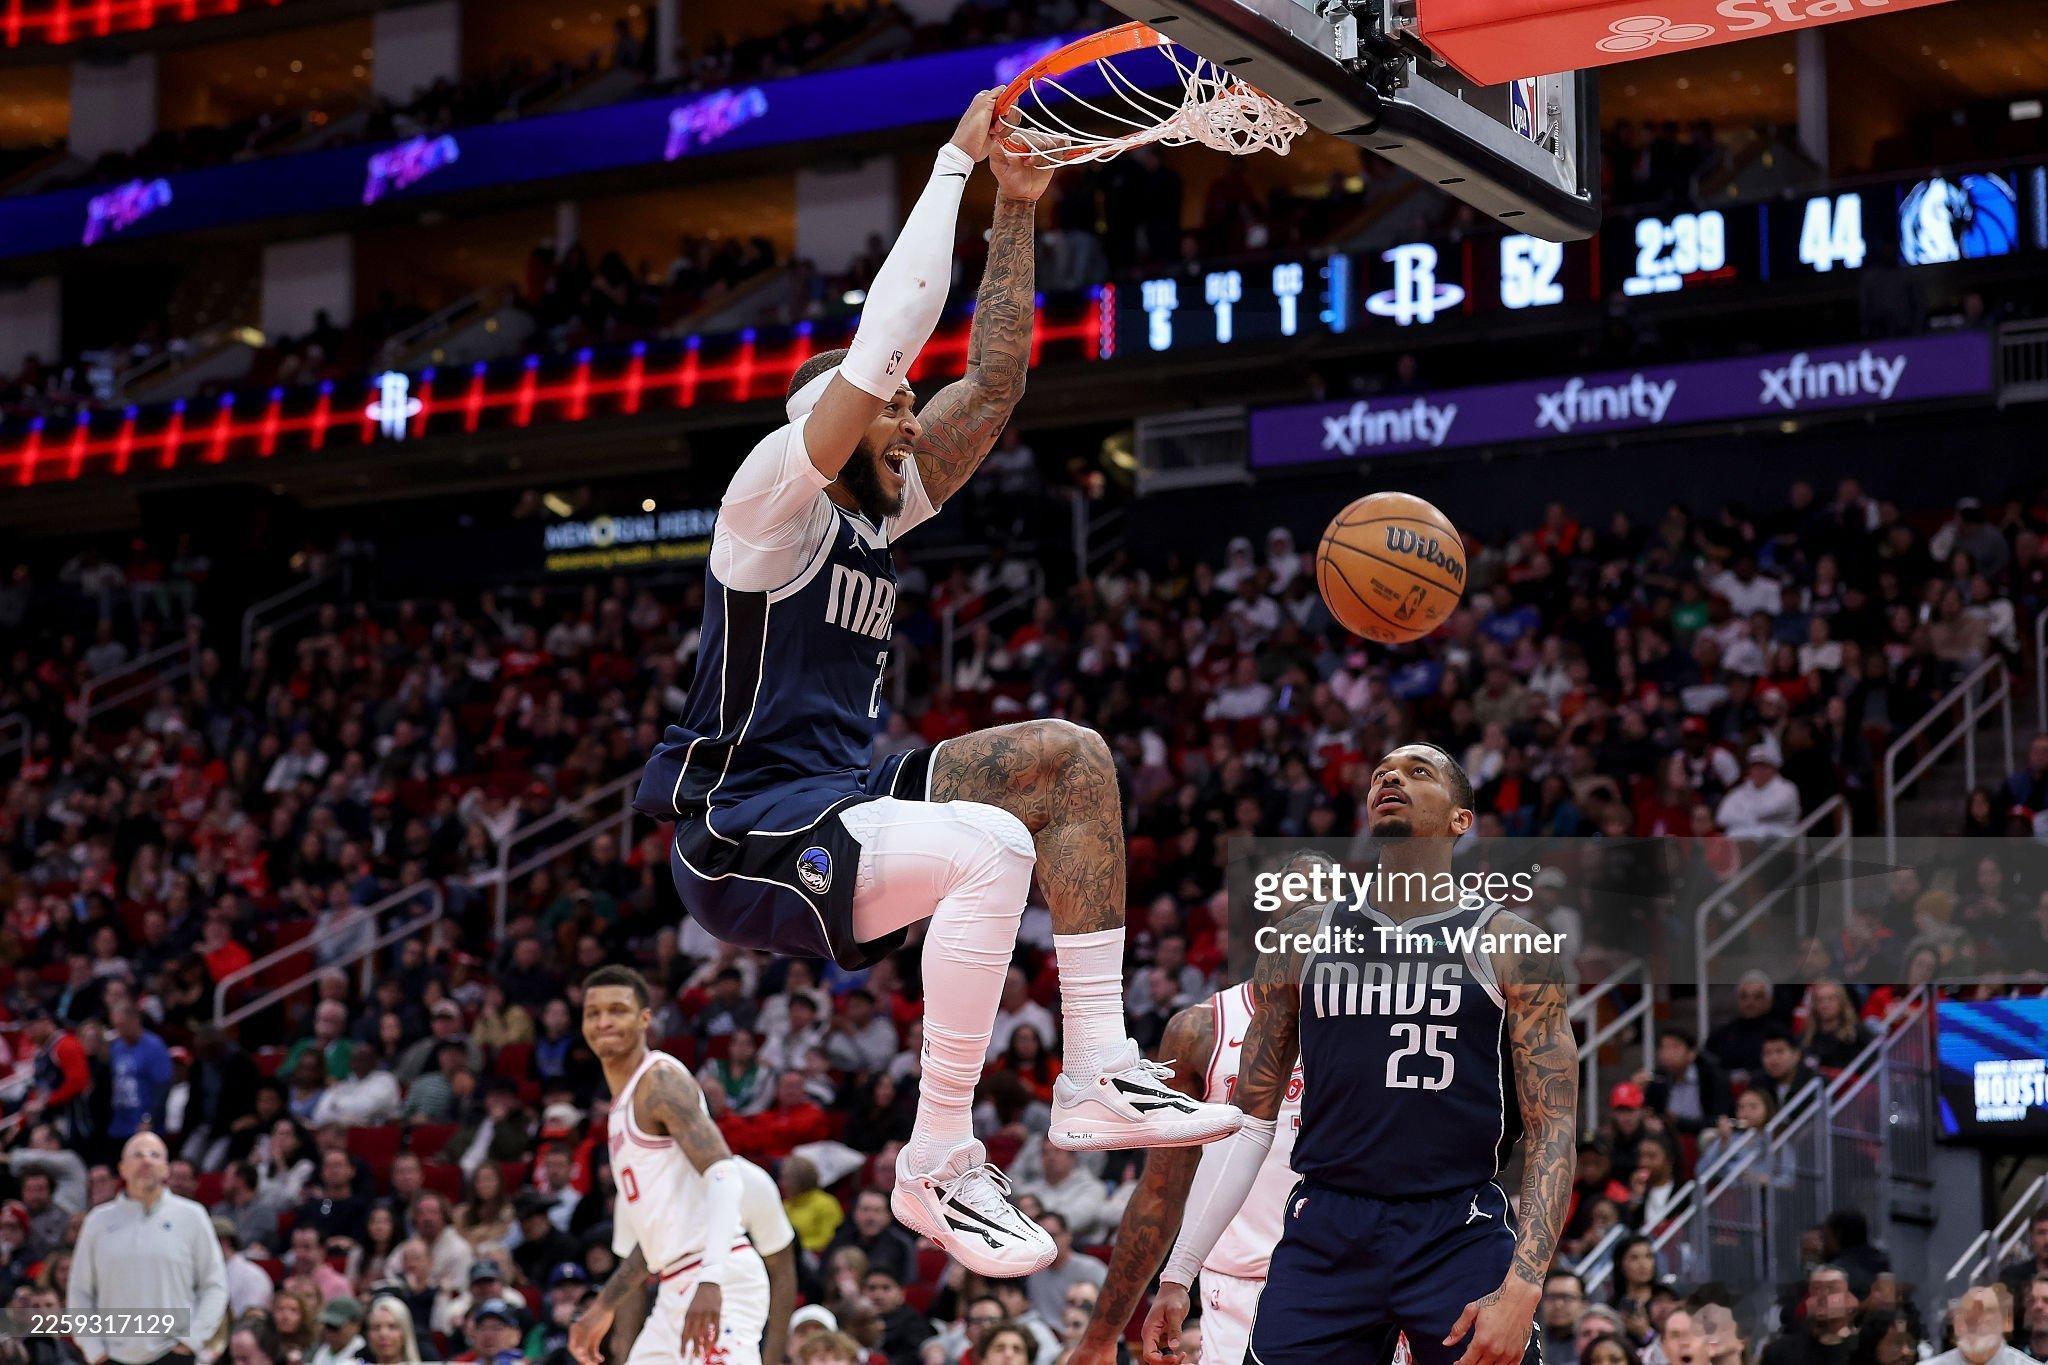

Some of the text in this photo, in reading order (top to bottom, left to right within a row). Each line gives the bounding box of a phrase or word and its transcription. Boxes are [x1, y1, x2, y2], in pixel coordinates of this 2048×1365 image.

[1635, 210, 1725, 277] 2:39
[1800, 194, 1866, 272] 44
[1501, 235, 1563, 308] 52
[1537, 375, 1676, 432] xfinity
[1762, 350, 1906, 408] xfinity
[1323, 400, 1457, 455] xfinity
[1386, 526, 1463, 584] Wilson
[1314, 962, 1463, 1018] MAVS
[1385, 1023, 1457, 1090] 25
